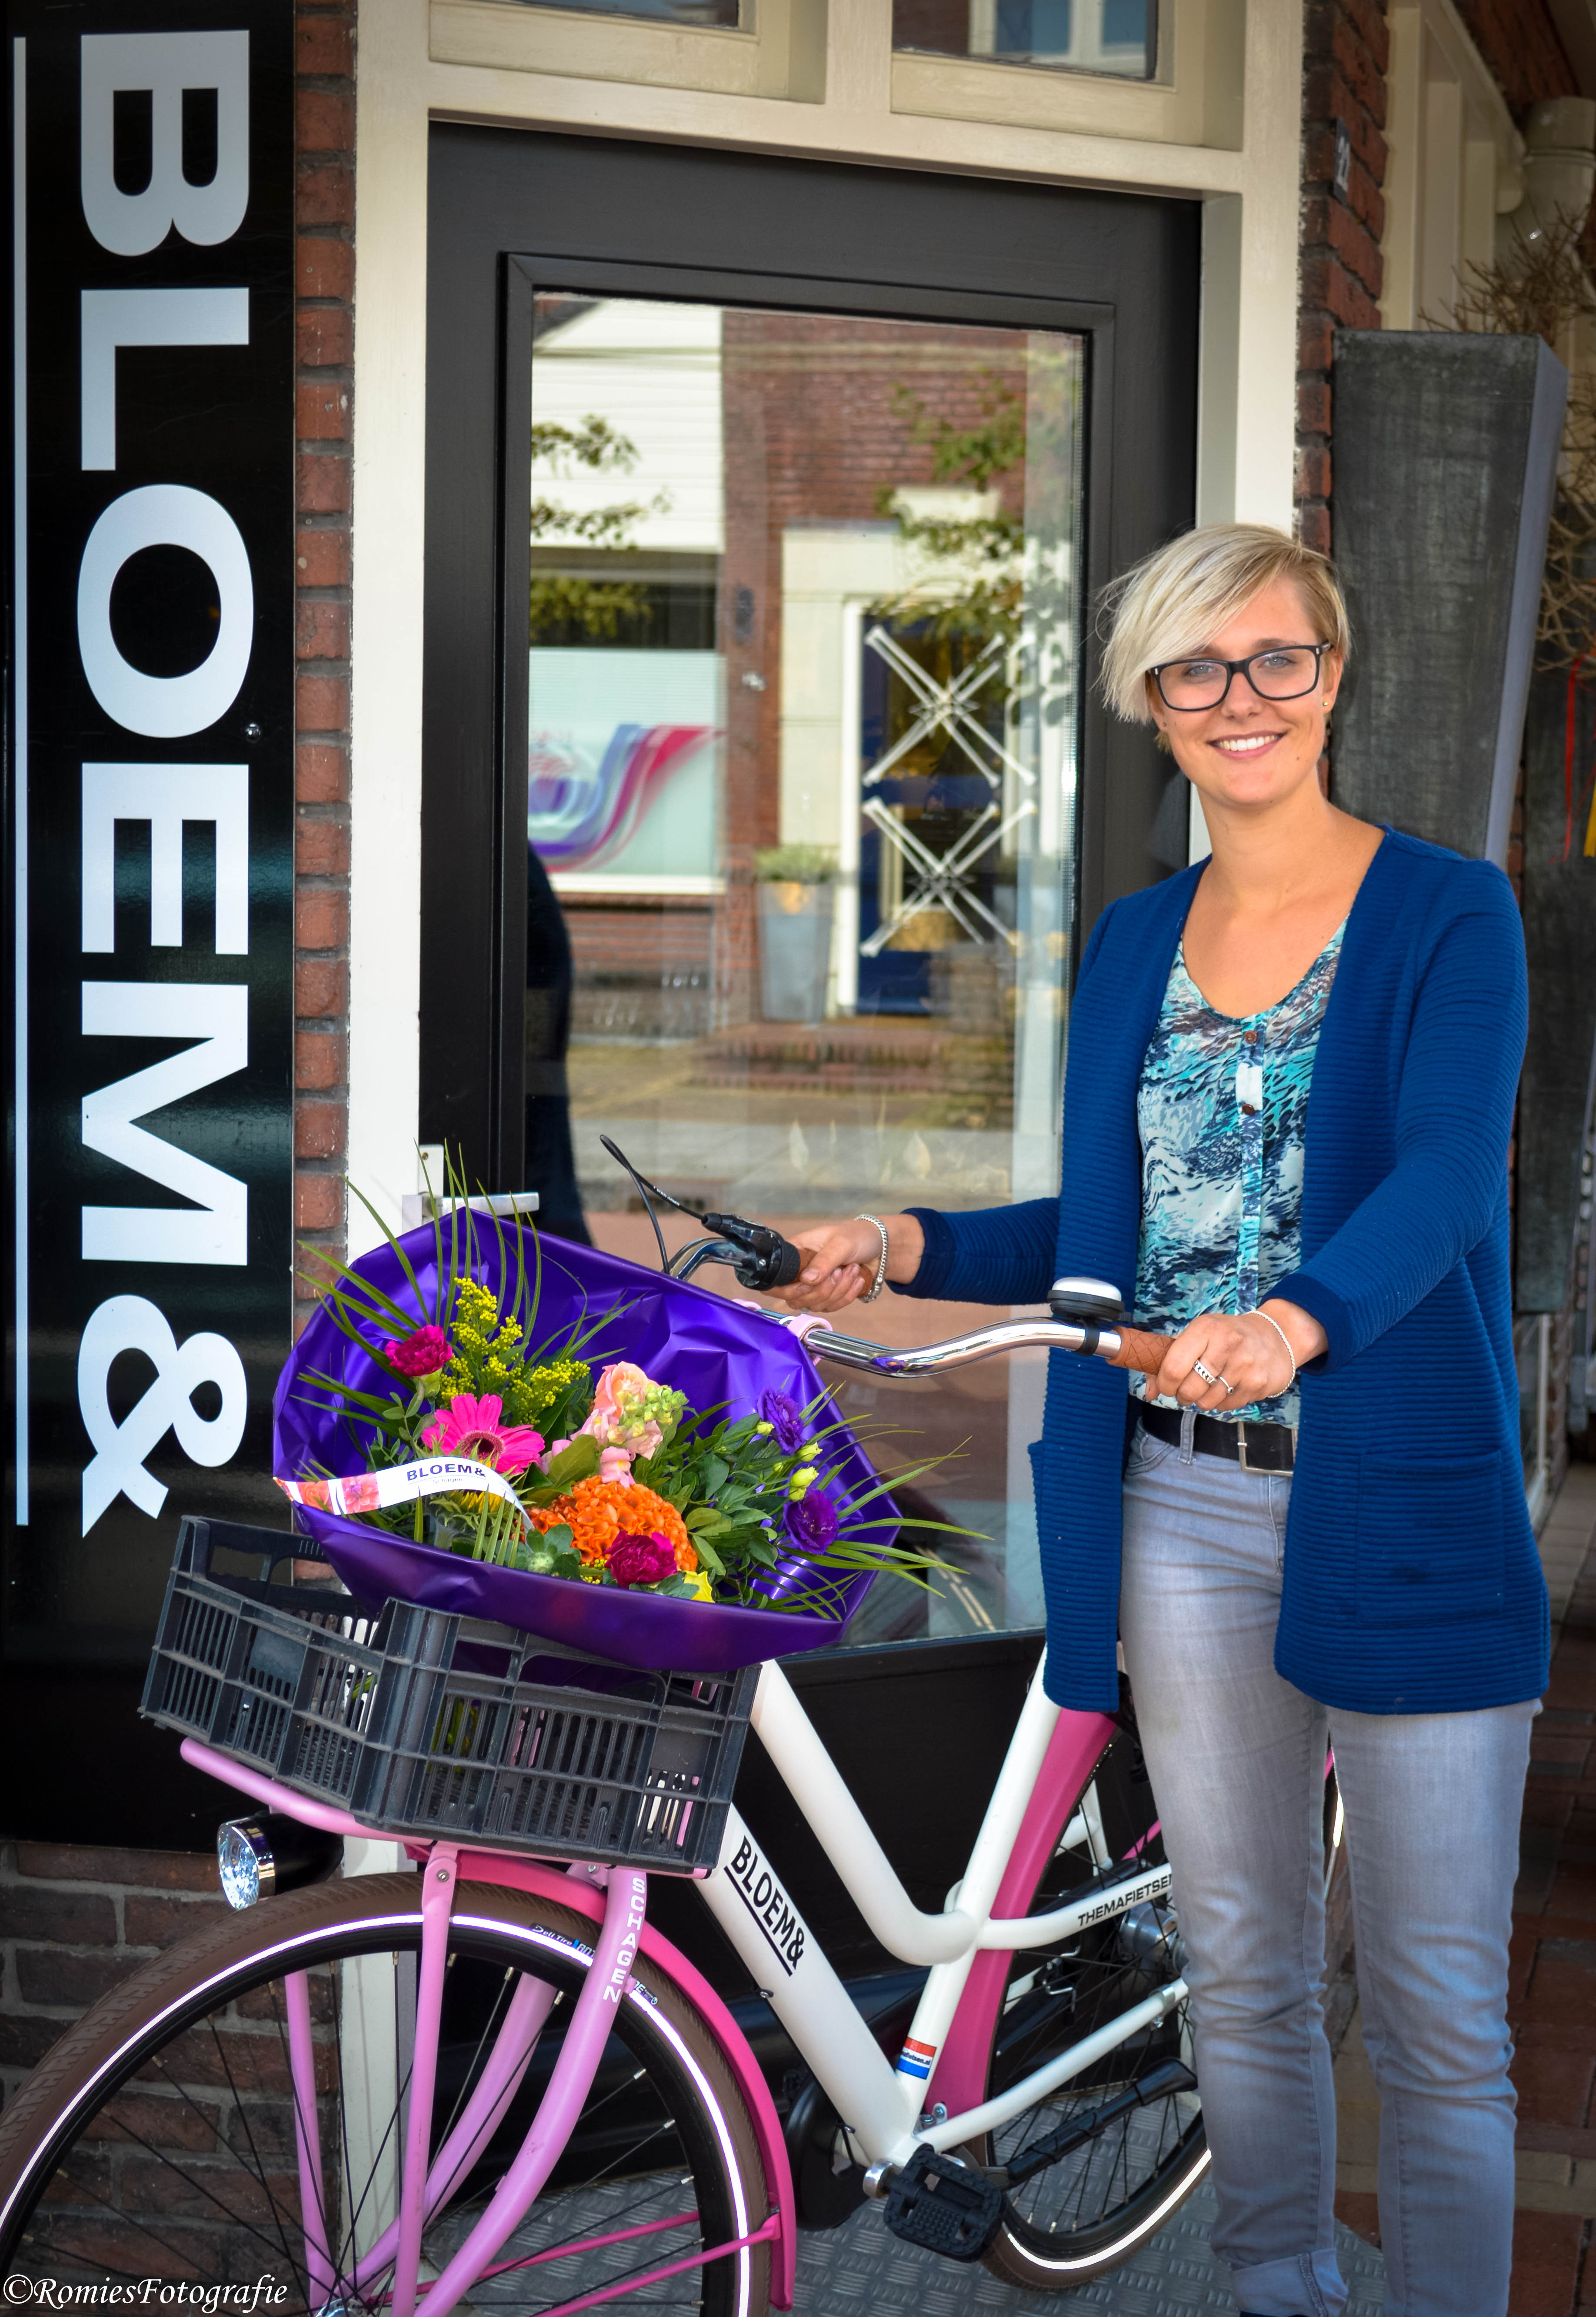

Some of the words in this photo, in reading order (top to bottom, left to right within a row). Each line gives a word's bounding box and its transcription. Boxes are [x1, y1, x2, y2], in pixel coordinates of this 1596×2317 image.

[78, 30, 254, 1539] BLOEM&
[406, 1464, 486, 1481] BLOEM&
[556, 1935, 573, 1945] Tire
[603, 1877, 646, 2003] SCHAGEN
[731, 1835, 805, 1970] BLOEM&
